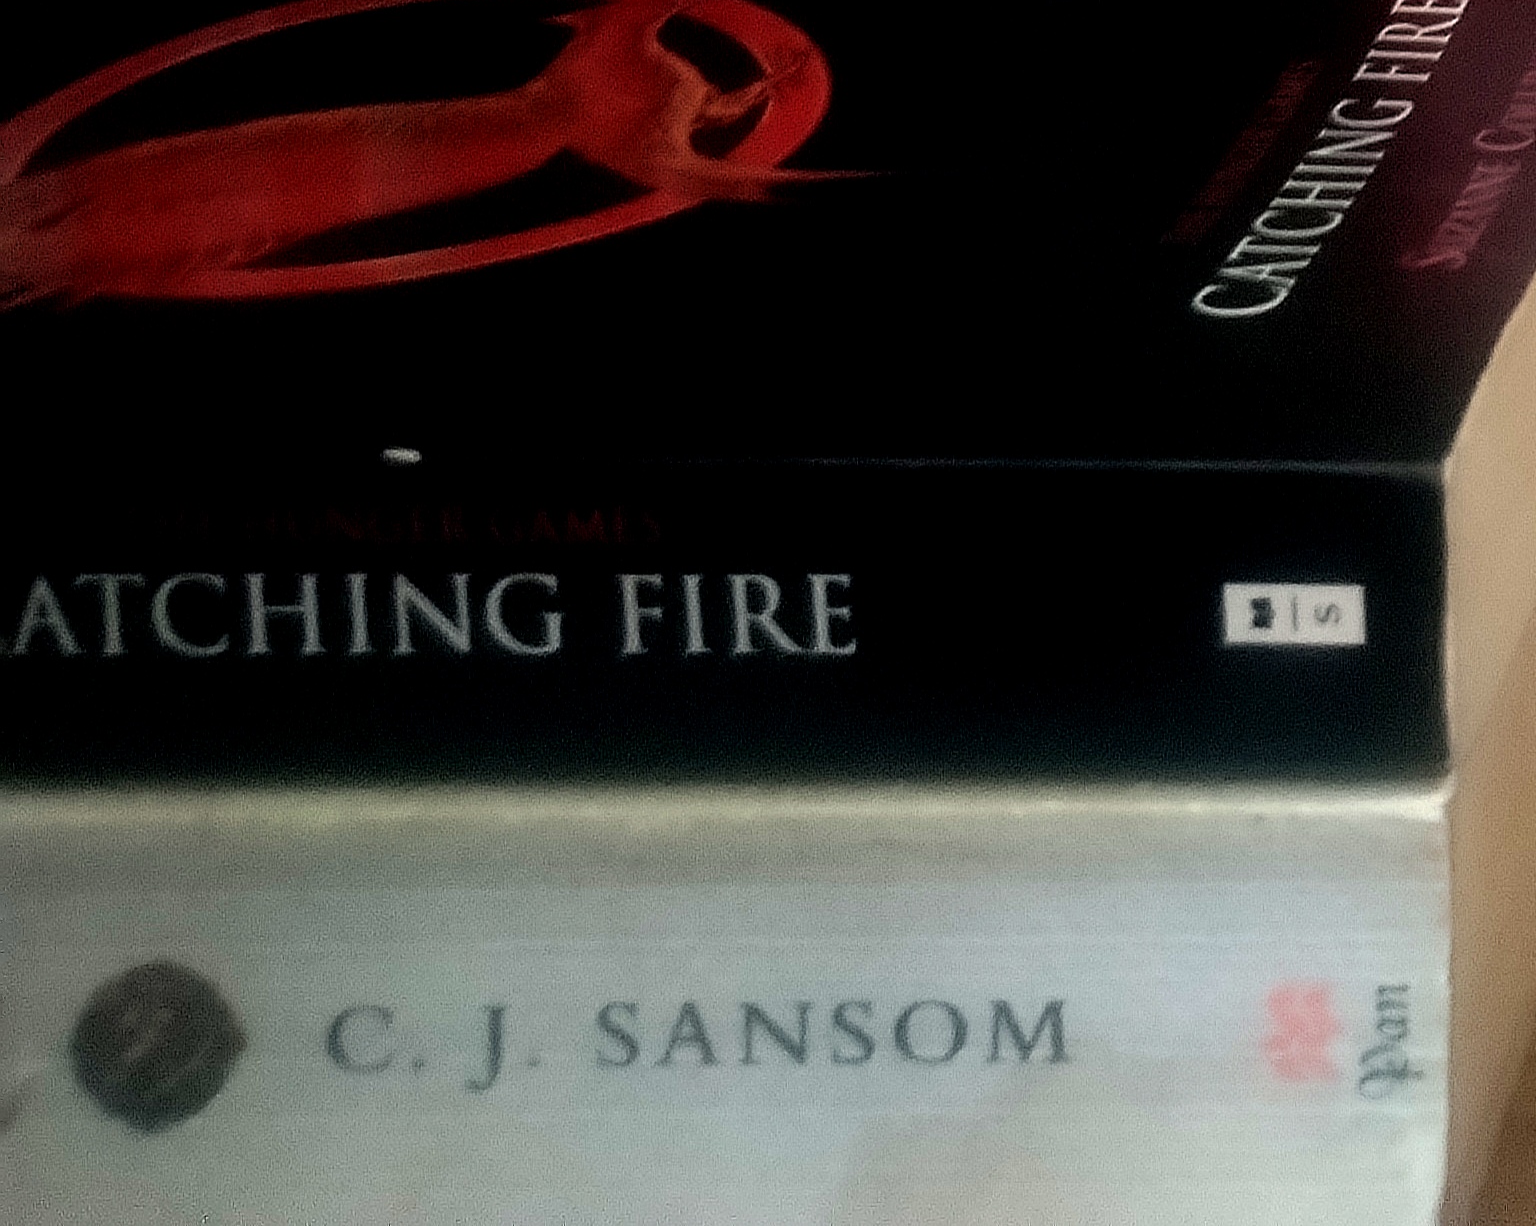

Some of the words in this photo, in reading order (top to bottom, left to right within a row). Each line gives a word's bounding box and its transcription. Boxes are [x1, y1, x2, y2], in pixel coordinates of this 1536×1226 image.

[1189, 97, 1415, 318] CATCHING
[0, 571, 565, 658] ATCHING
[615, 570, 859, 658] FIRE
[325, 1003, 427, 1076] C.
[597, 998, 1073, 1070] SANSOM
